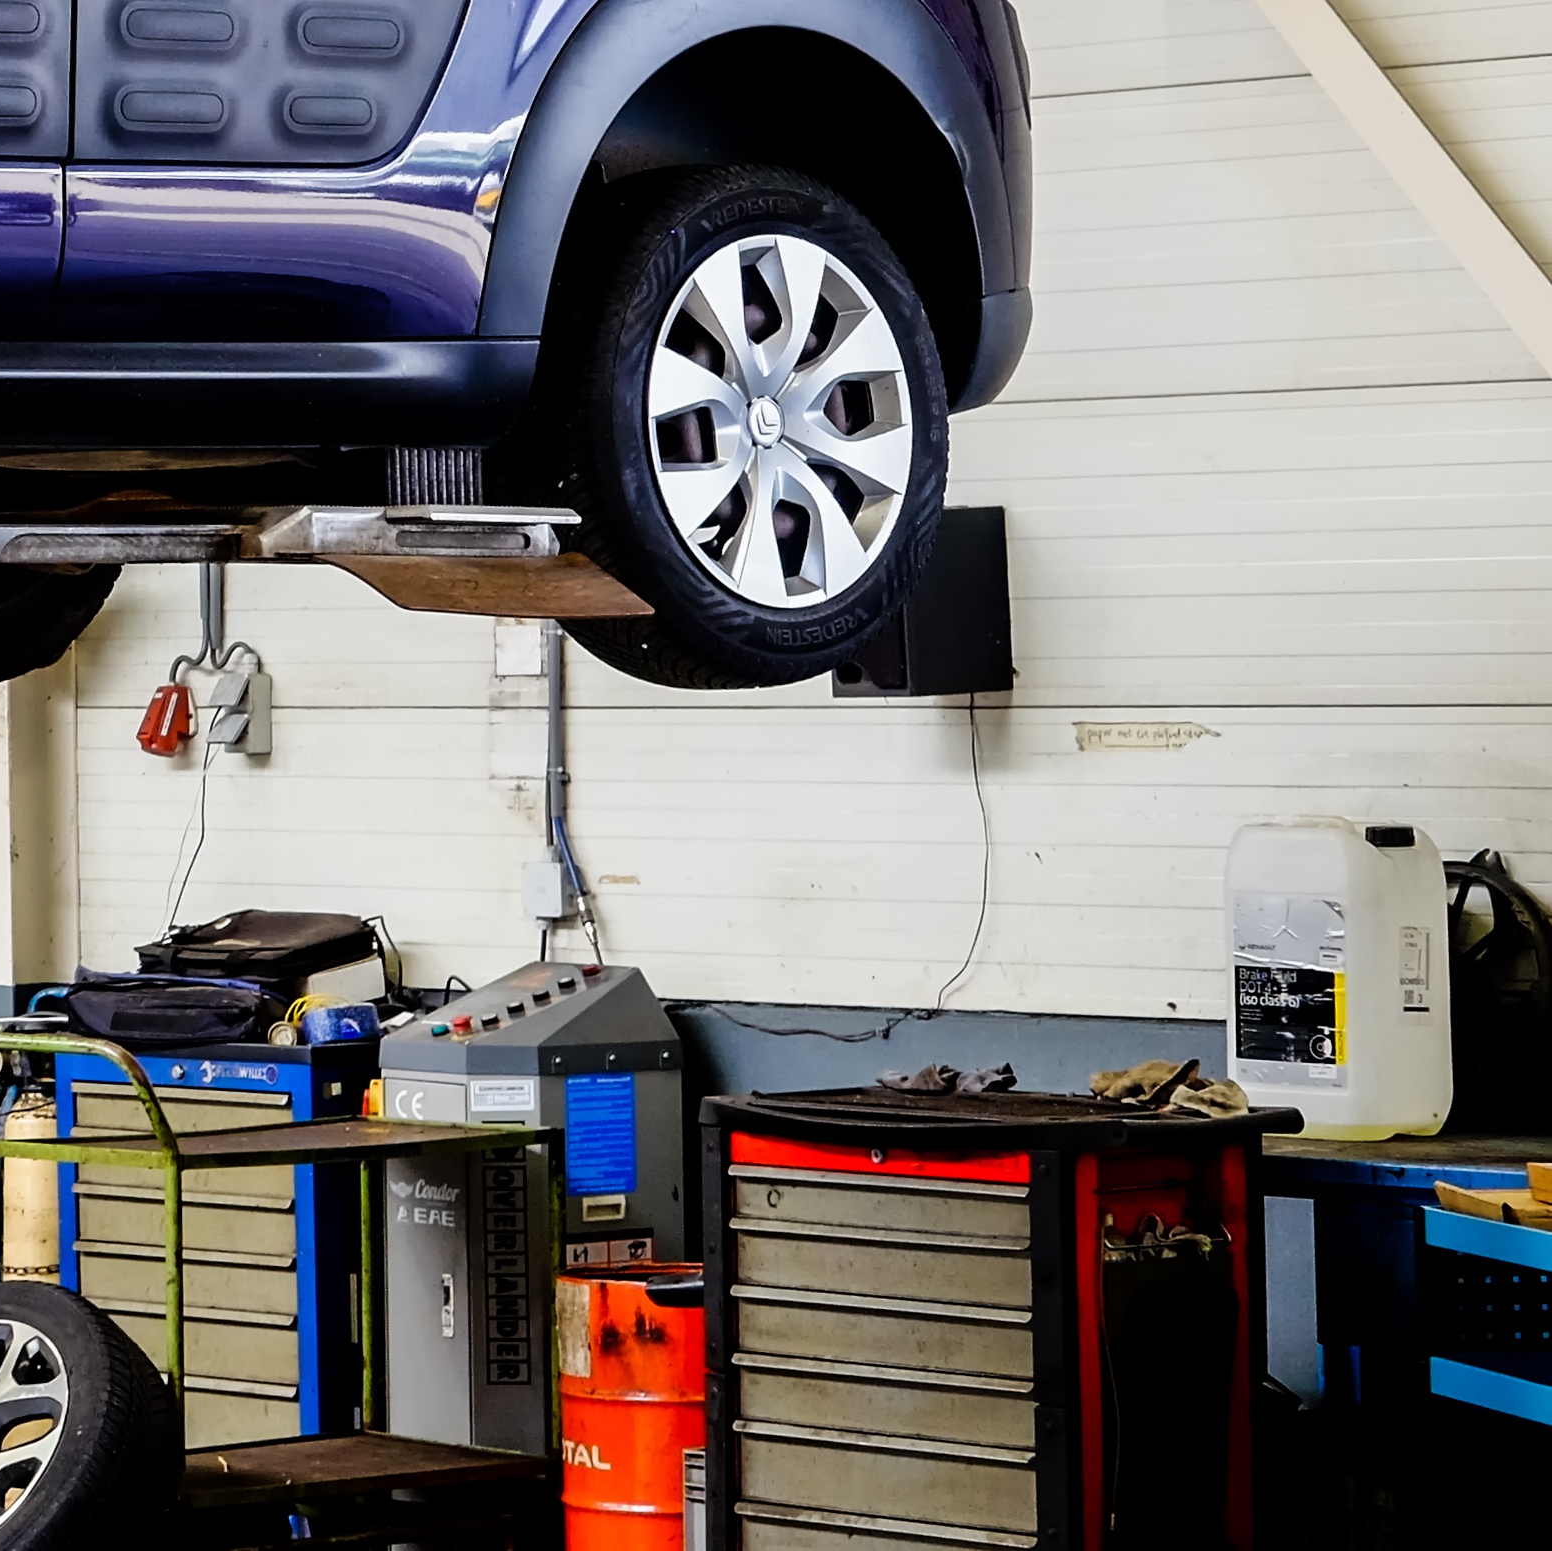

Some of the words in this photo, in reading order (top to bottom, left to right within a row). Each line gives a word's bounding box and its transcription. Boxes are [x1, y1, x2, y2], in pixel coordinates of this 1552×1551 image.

[700, 196, 804, 232] VREDESTEIN
[766, 607, 870, 646] VREDESTEIN
[1239, 968, 1268, 981] Brake
[1239, 981, 1262, 993] DOT
[414, 1178, 460, 1203] Condor
[491, 1169, 522, 1382] OVERLANDER
[562, 1437, 611, 1471] TAL
